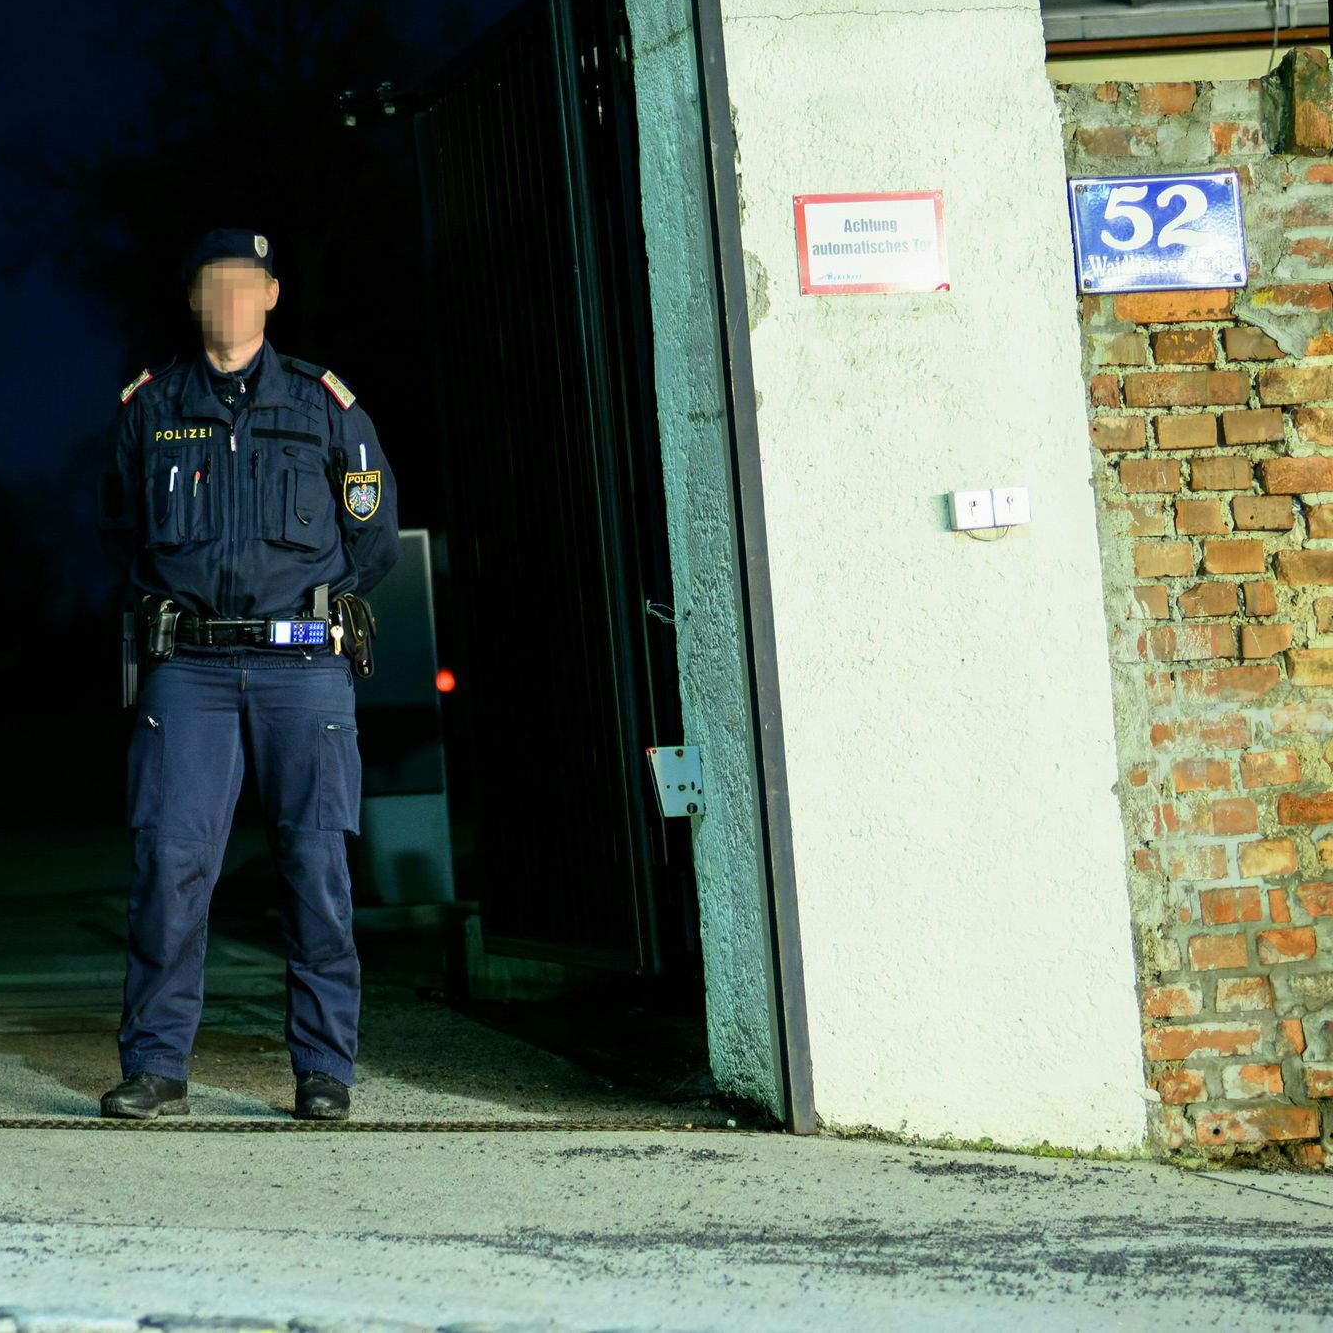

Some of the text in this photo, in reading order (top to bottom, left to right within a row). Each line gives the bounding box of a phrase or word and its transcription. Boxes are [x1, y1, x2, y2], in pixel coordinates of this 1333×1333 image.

[1100, 184, 1209, 251] 52
[844, 219, 897, 233] Achtung
[813, 239, 909, 256] automatisches
[155, 427, 212, 442] POLIZEI
[348, 475, 377, 484] POLIZEI
